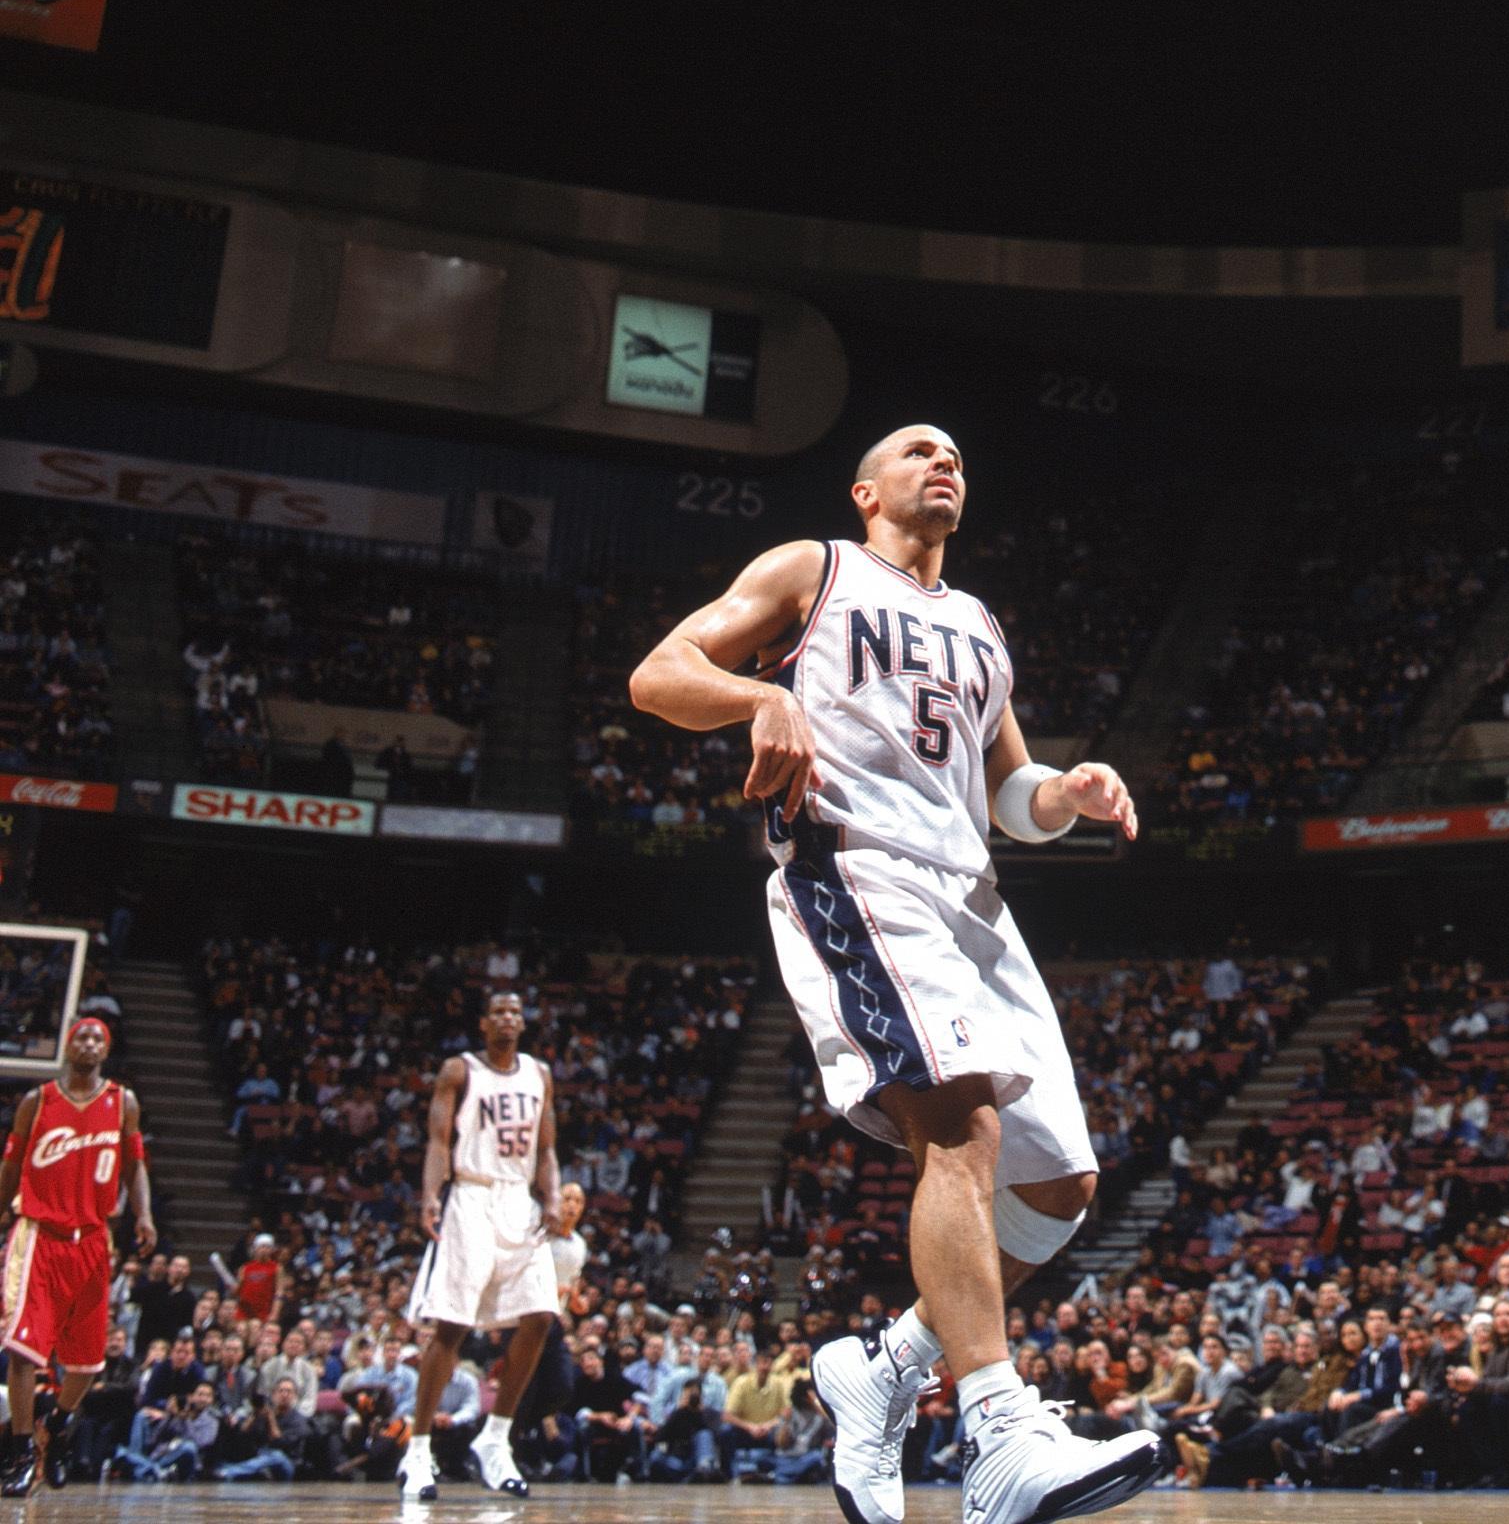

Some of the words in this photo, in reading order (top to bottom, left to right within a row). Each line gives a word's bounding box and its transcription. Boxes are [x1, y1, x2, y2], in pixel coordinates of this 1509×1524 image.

[35, 450, 329, 526] SEATS
[676, 476, 764, 518] 225
[911, 680, 957, 768] 5
[185, 789, 363, 831] SHARP
[497, 1125, 533, 1158] 55
[94, 1148, 117, 1185] 0
